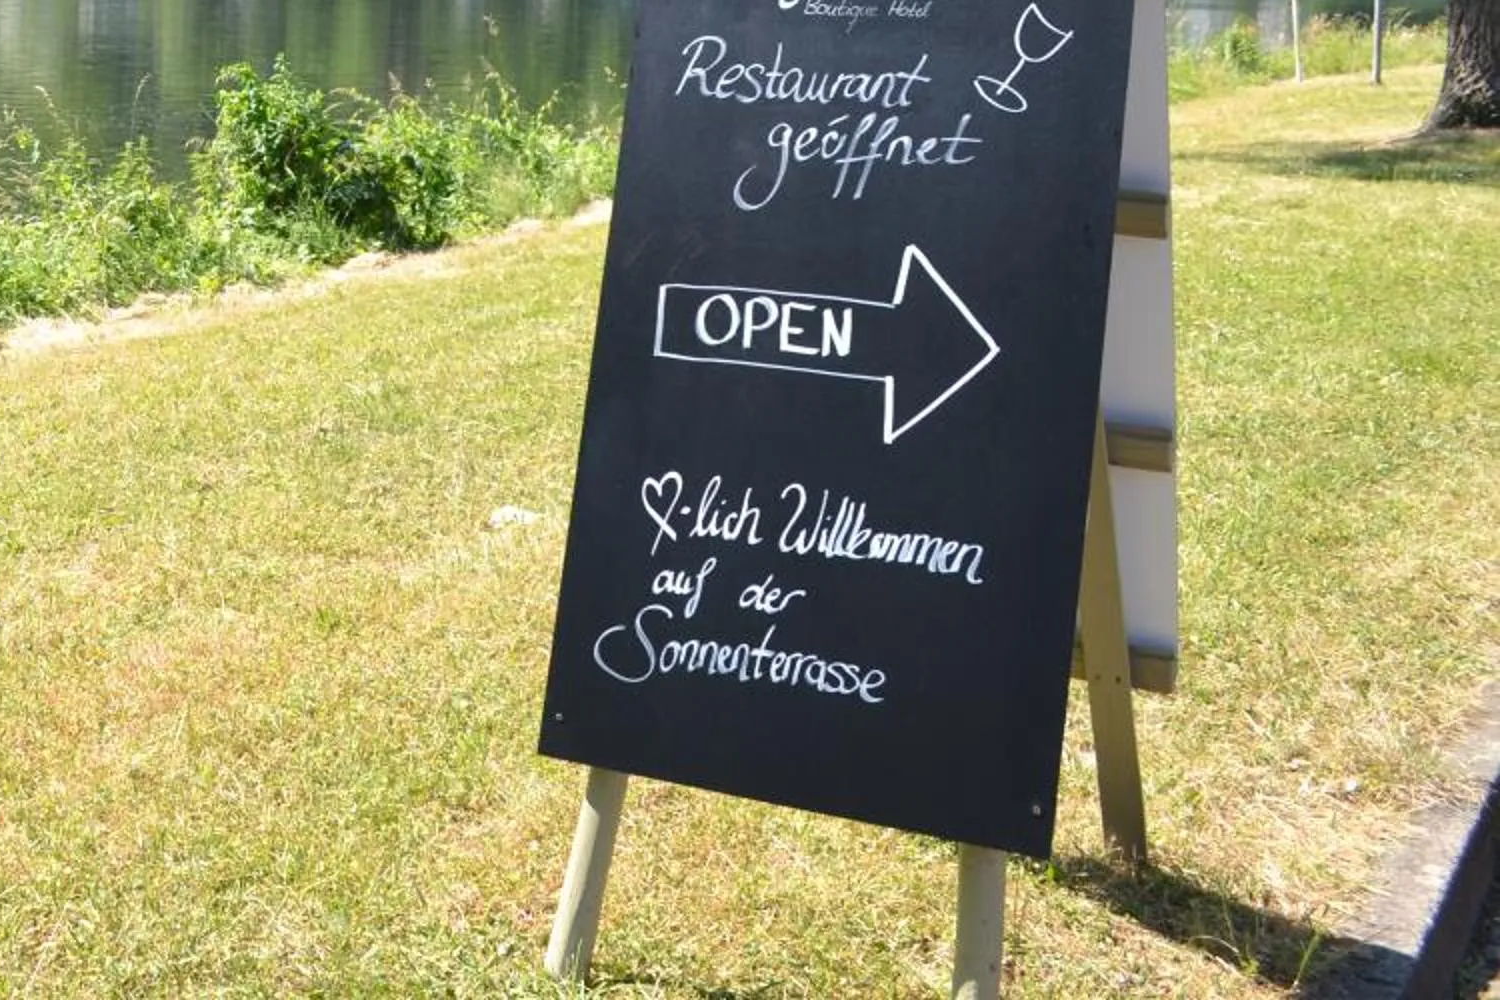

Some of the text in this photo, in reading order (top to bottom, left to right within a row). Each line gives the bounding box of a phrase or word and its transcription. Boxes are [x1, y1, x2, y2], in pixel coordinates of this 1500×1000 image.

[887, 0, 933, 19] Hotel
[675, 34, 932, 108] Restaurant
[695, 293, 853, 357] OPEN
[778, 482, 985, 585] Willkommen
[651, 557, 807, 619] auf der
[593, 604, 886, 704] Sonnenterrasse
